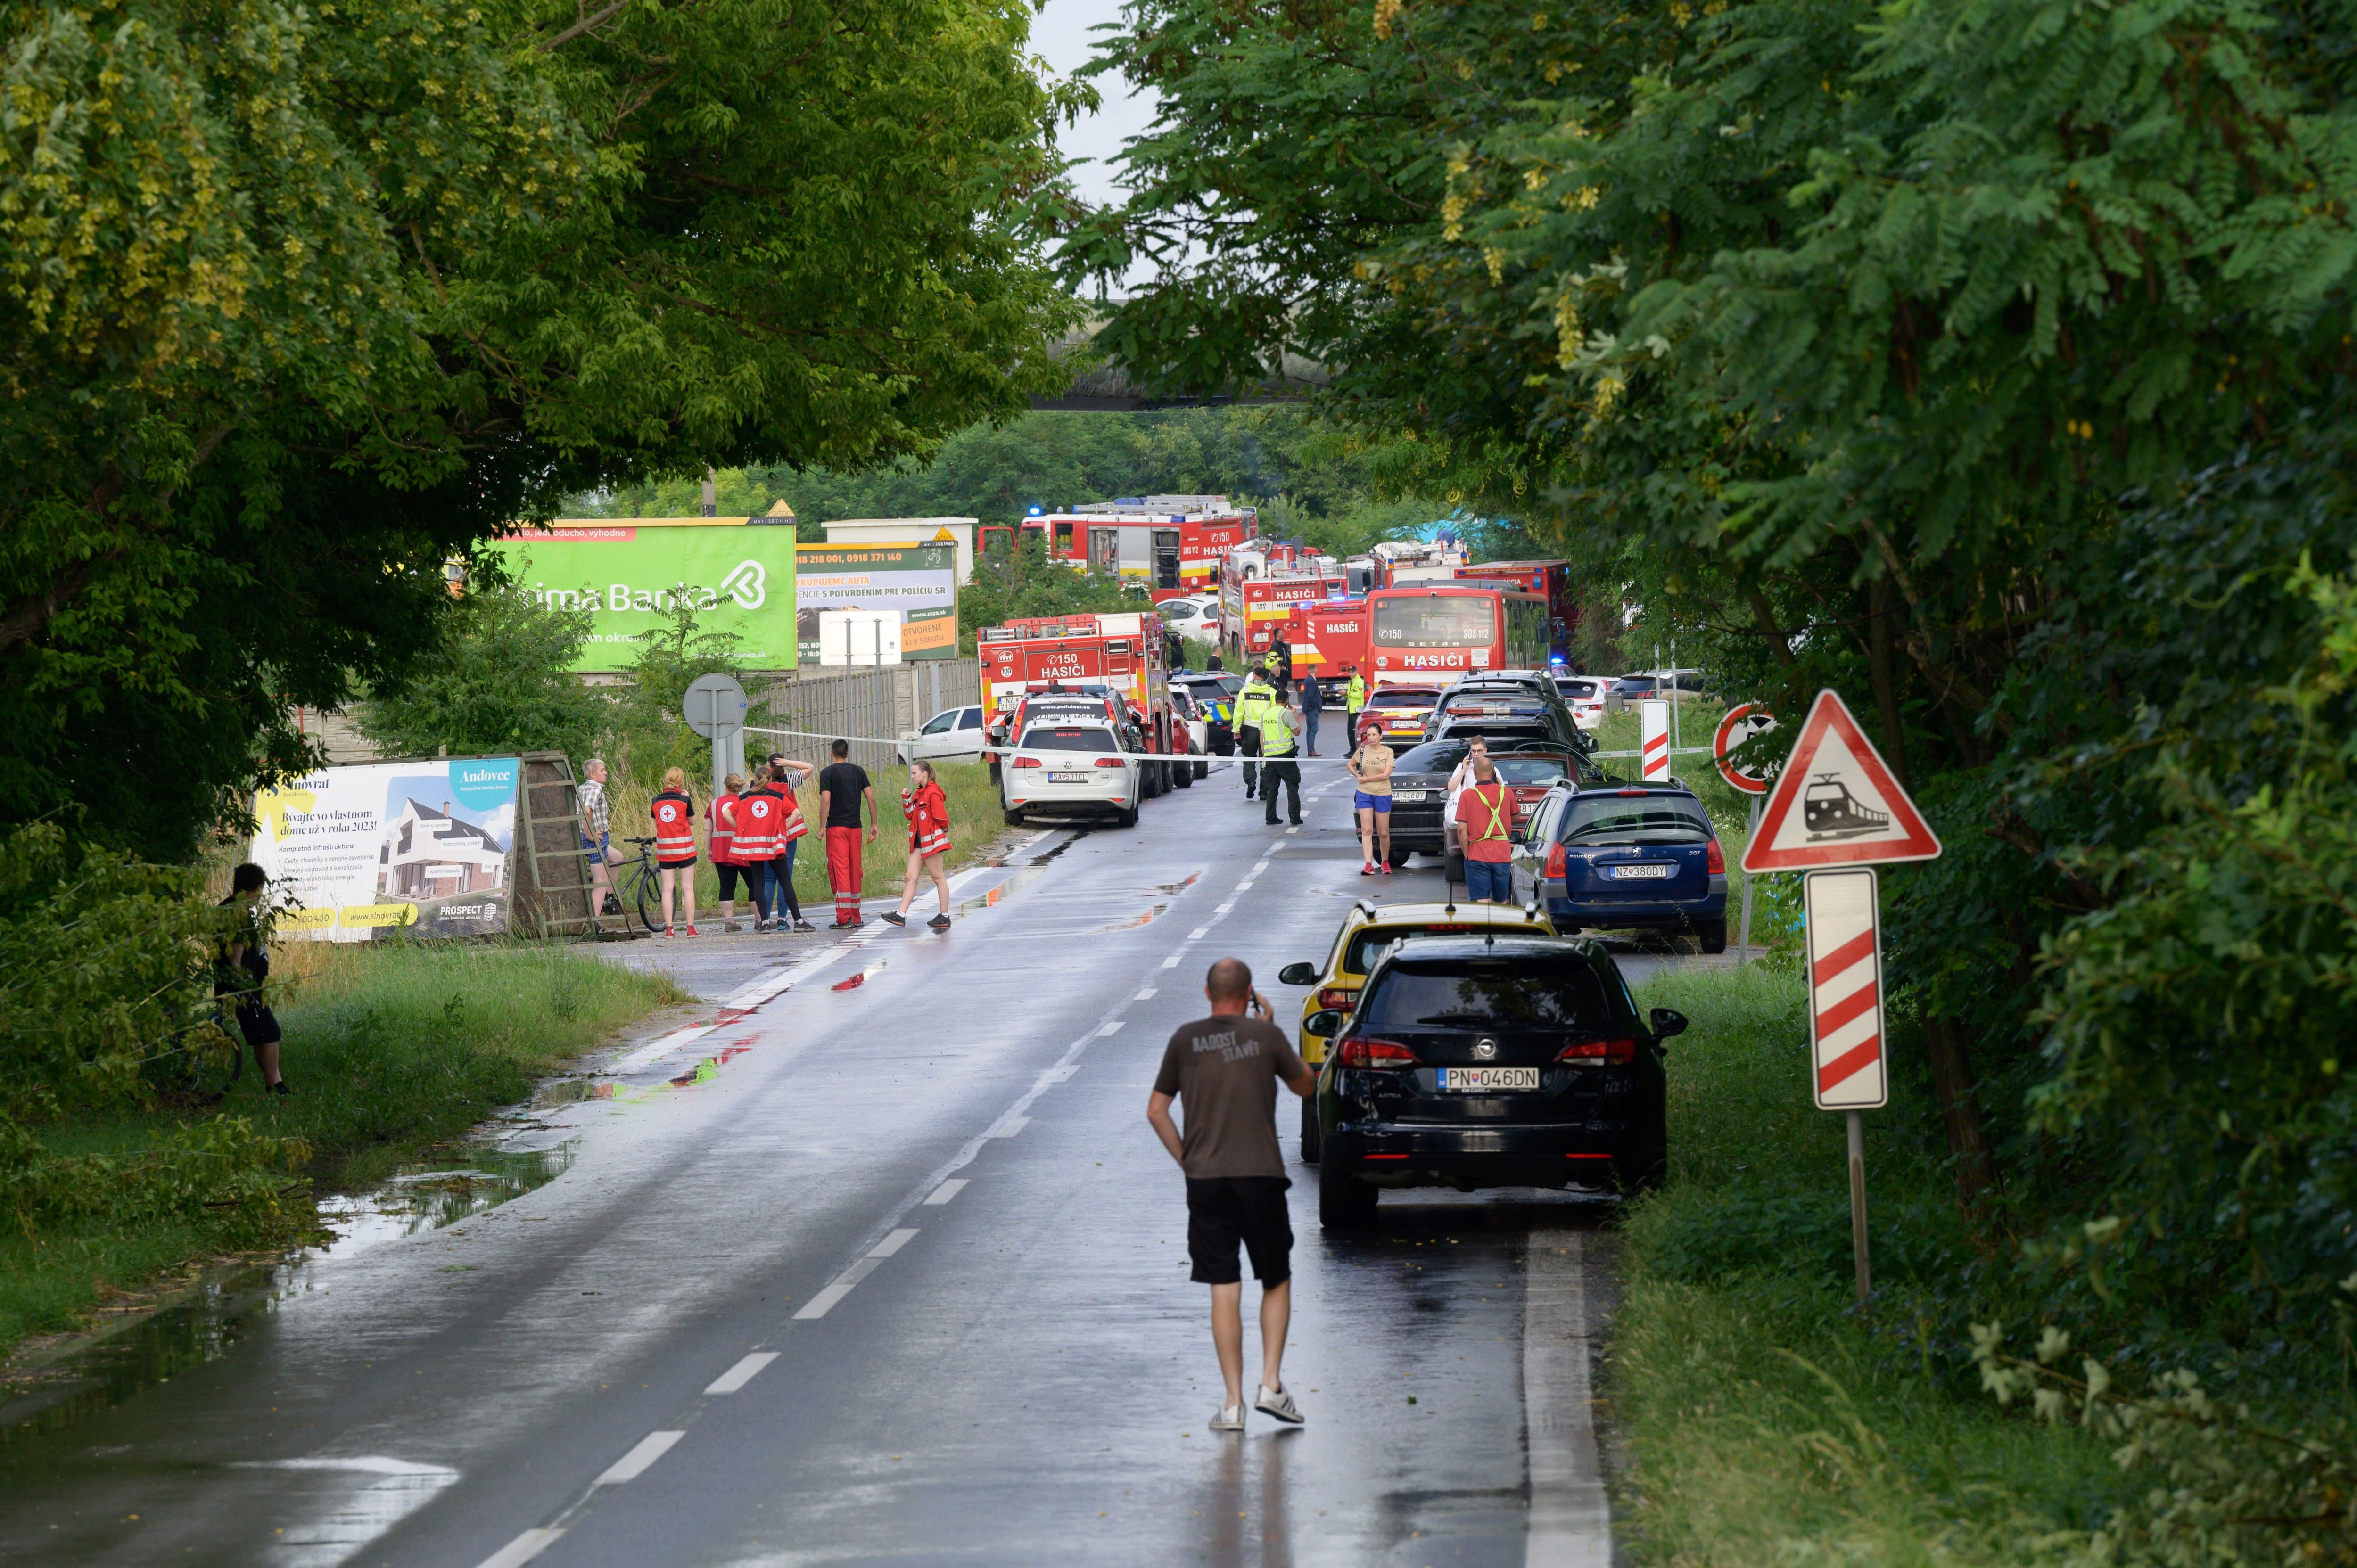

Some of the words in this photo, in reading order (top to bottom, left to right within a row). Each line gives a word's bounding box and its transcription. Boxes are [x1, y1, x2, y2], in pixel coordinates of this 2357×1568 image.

[589, 528, 626, 537] výhodne
[1219, 532, 1229, 542] 150
[1203, 543, 1237, 555] HASIČ
[810, 555, 824, 564] 218
[826, 555, 844, 564] 001,
[847, 554, 868, 562] 0918
[871, 553, 884, 562] 371
[887, 553, 902, 561] 140
[796, 578, 845, 586] YKUPUJEME
[848, 575, 870, 585] AUTÁ
[830, 587, 882, 597] POTVRDENÍM
[902, 585, 932, 594] POLÍCIU
[1277, 589, 1315, 599] HASIČI
[912, 610, 946, 618] www.zsza.sk
[903, 622, 943, 636] OTVORENÉ
[1327, 621, 1358, 633] HASIČI
[606, 632, 640, 643] okre
[920, 634, 944, 644] SOBOTU
[1389, 630, 1402, 639] 150
[1463, 629, 1476, 638] SOS
[1479, 629, 1489, 638] 112
[1057, 653, 1078, 664] 150
[1404, 652, 1463, 666] HASIČI
[1041, 664, 1085, 678] HASIČI
[460, 769, 510, 782] Andovce
[282, 812, 315, 824] Bývajte
[330, 810, 372, 820] vlastnom
[280, 826, 306, 835] dome
[309, 825, 319, 834] už
[329, 823, 350, 833] roku
[352, 821, 377, 831] 2023!
[279, 845, 311, 853] Kompletná
[1616, 867, 1628, 877] NZ
[1634, 866, 1664, 876] 380DY
[440, 905, 482, 915] PROSPECT
[314, 914, 329, 922] 400
[350, 911, 401, 921] www.slnovrat
[1449, 1070, 1470, 1086] PN
[1481, 1070, 1535, 1086] 046DN
